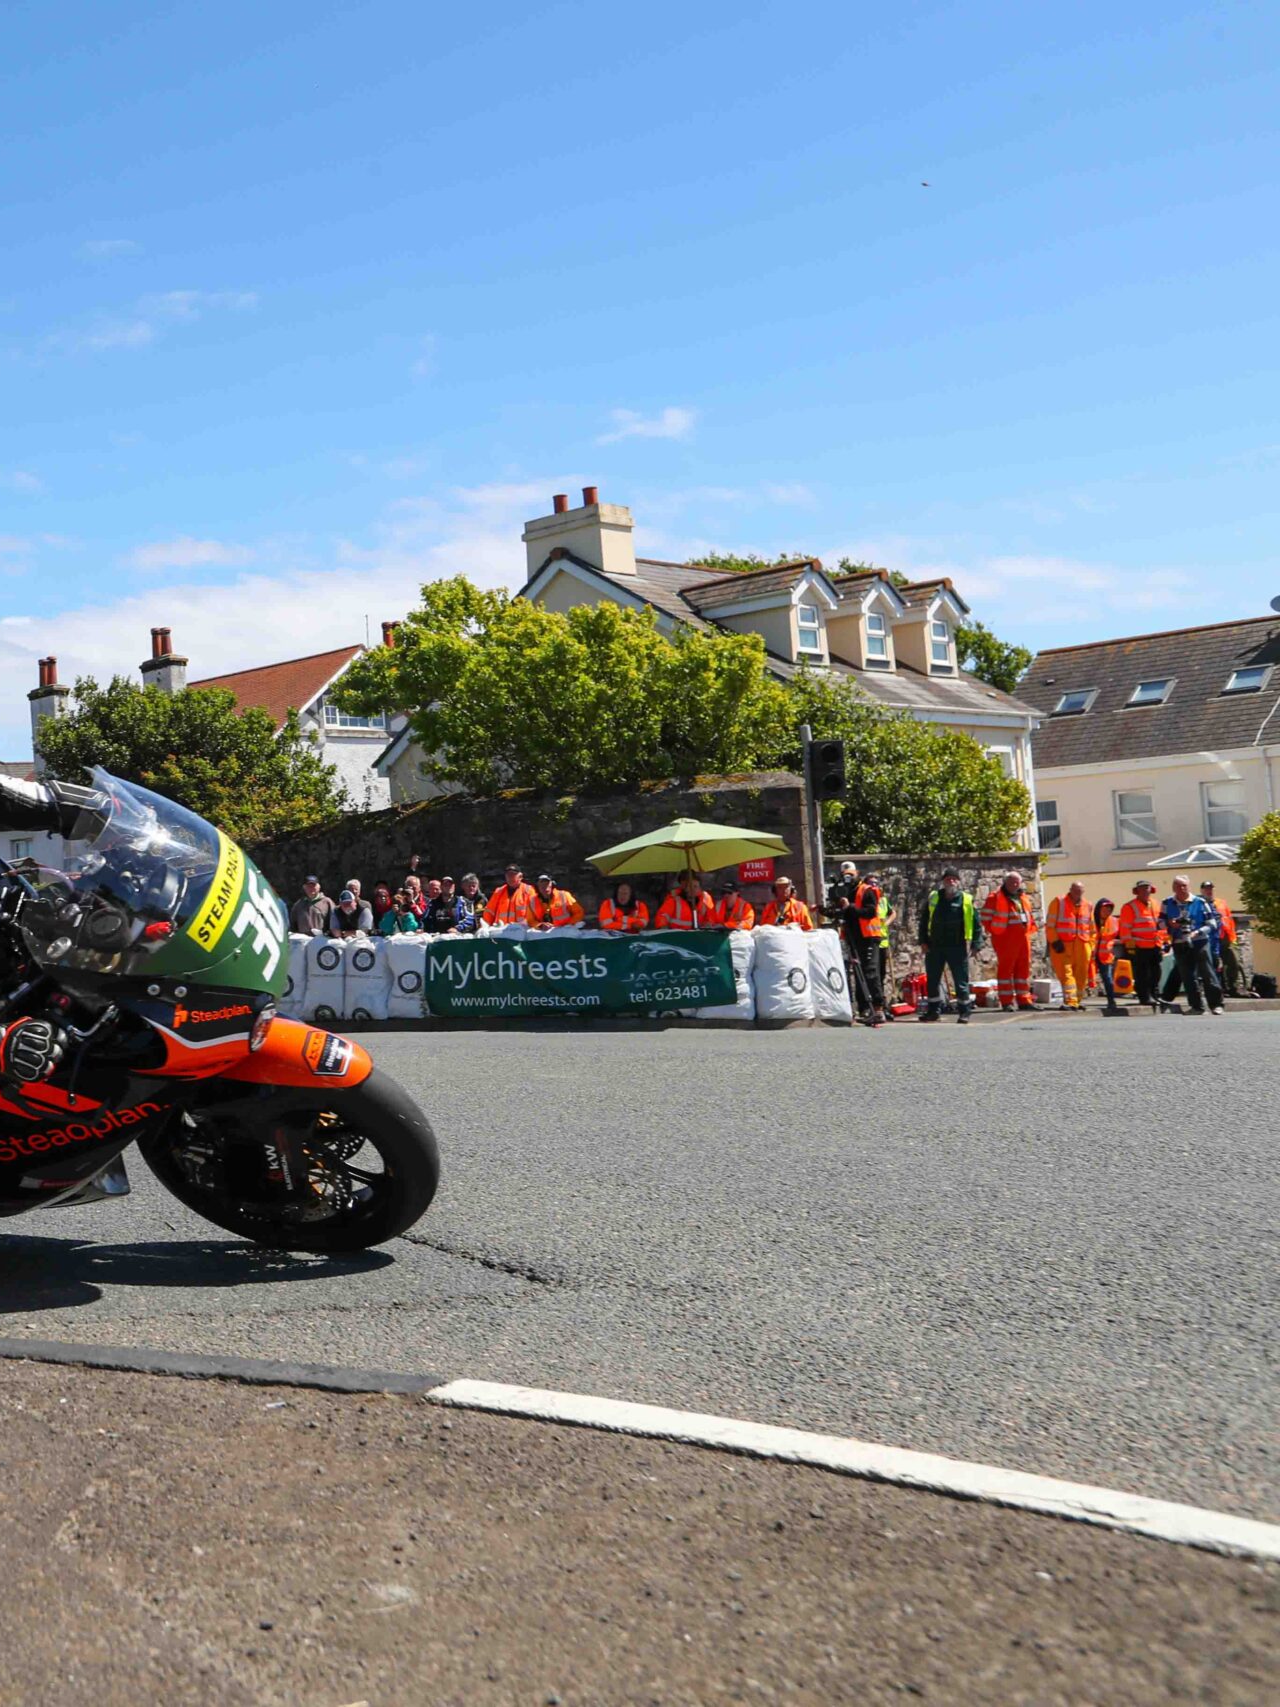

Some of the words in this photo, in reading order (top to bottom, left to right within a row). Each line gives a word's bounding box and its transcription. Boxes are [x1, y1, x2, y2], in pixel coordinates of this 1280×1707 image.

[743, 869, 770, 879] POINT
[746, 861, 767, 870] FIRE
[197, 879, 233, 943] STEAM
[231, 868, 284, 983] 36
[429, 951, 608, 989] Mylchreests
[622, 965, 721, 983] JAGUAR
[450, 993, 601, 1009] www.mylchreests.com
[629, 988, 653, 1003] tel:
[655, 984, 708, 1001] 623481
